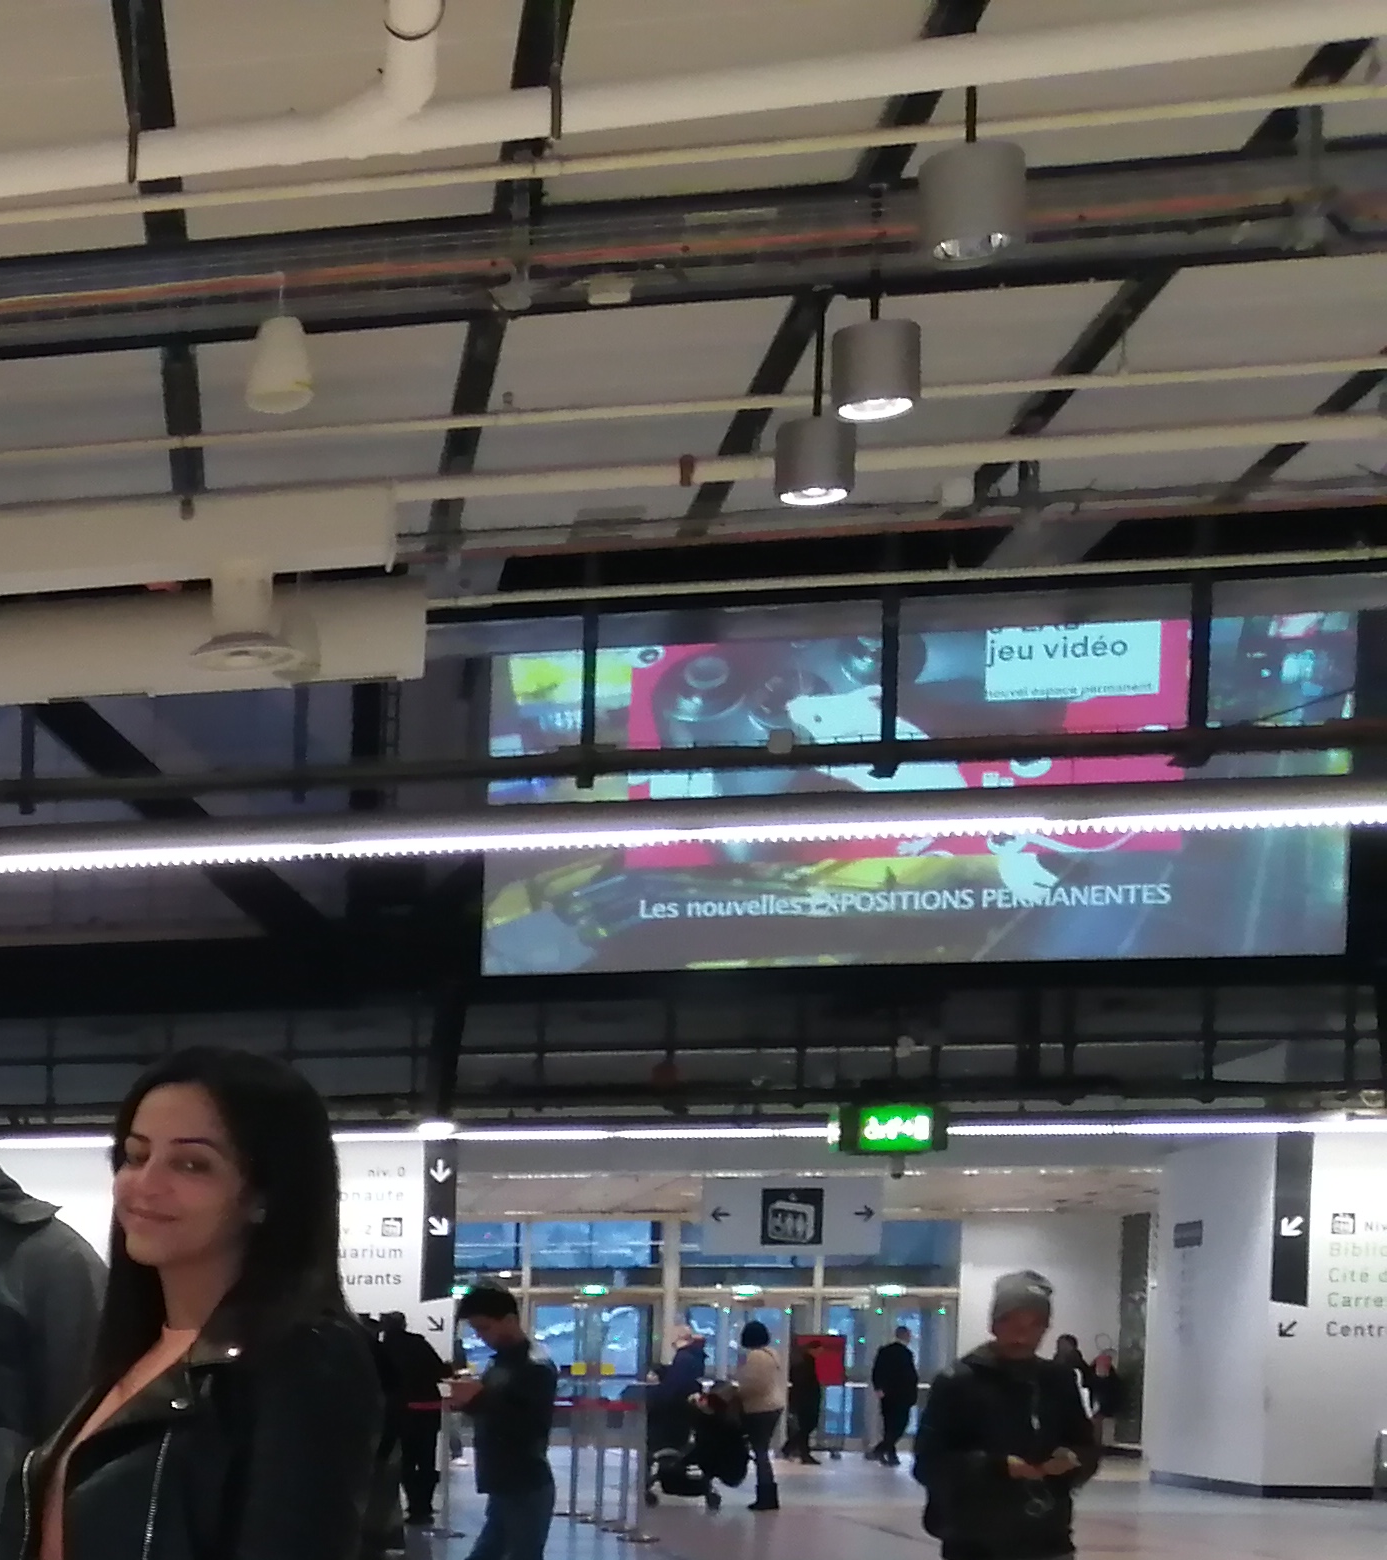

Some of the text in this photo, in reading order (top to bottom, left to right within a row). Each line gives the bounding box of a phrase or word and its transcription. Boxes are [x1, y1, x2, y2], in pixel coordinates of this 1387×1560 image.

[984, 634, 1129, 668] jeu vidéo
[639, 899, 678, 920] Les
[685, 896, 802, 918] nouvelles
